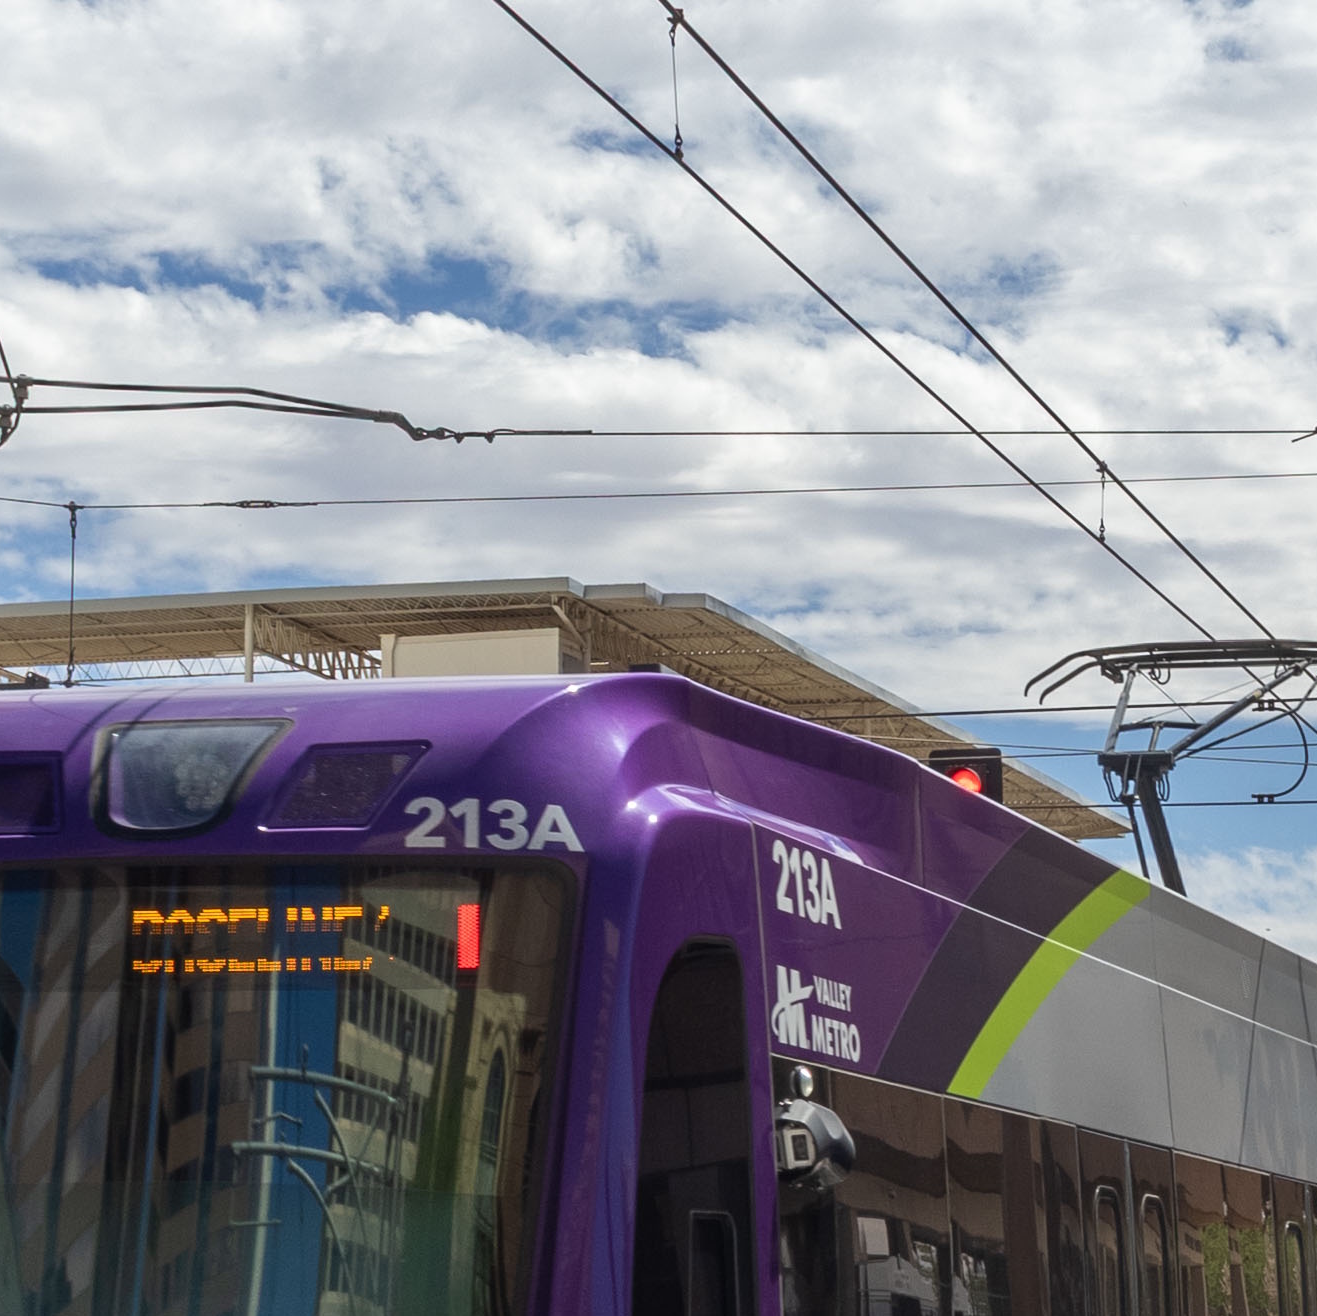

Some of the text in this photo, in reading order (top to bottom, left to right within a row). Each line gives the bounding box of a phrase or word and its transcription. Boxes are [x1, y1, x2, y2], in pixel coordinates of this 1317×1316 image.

[404, 796, 584, 852] 213A
[772, 839, 841, 930] 213A
[813, 975, 852, 1013] VALLEY
[811, 1014, 861, 1064] METRO
